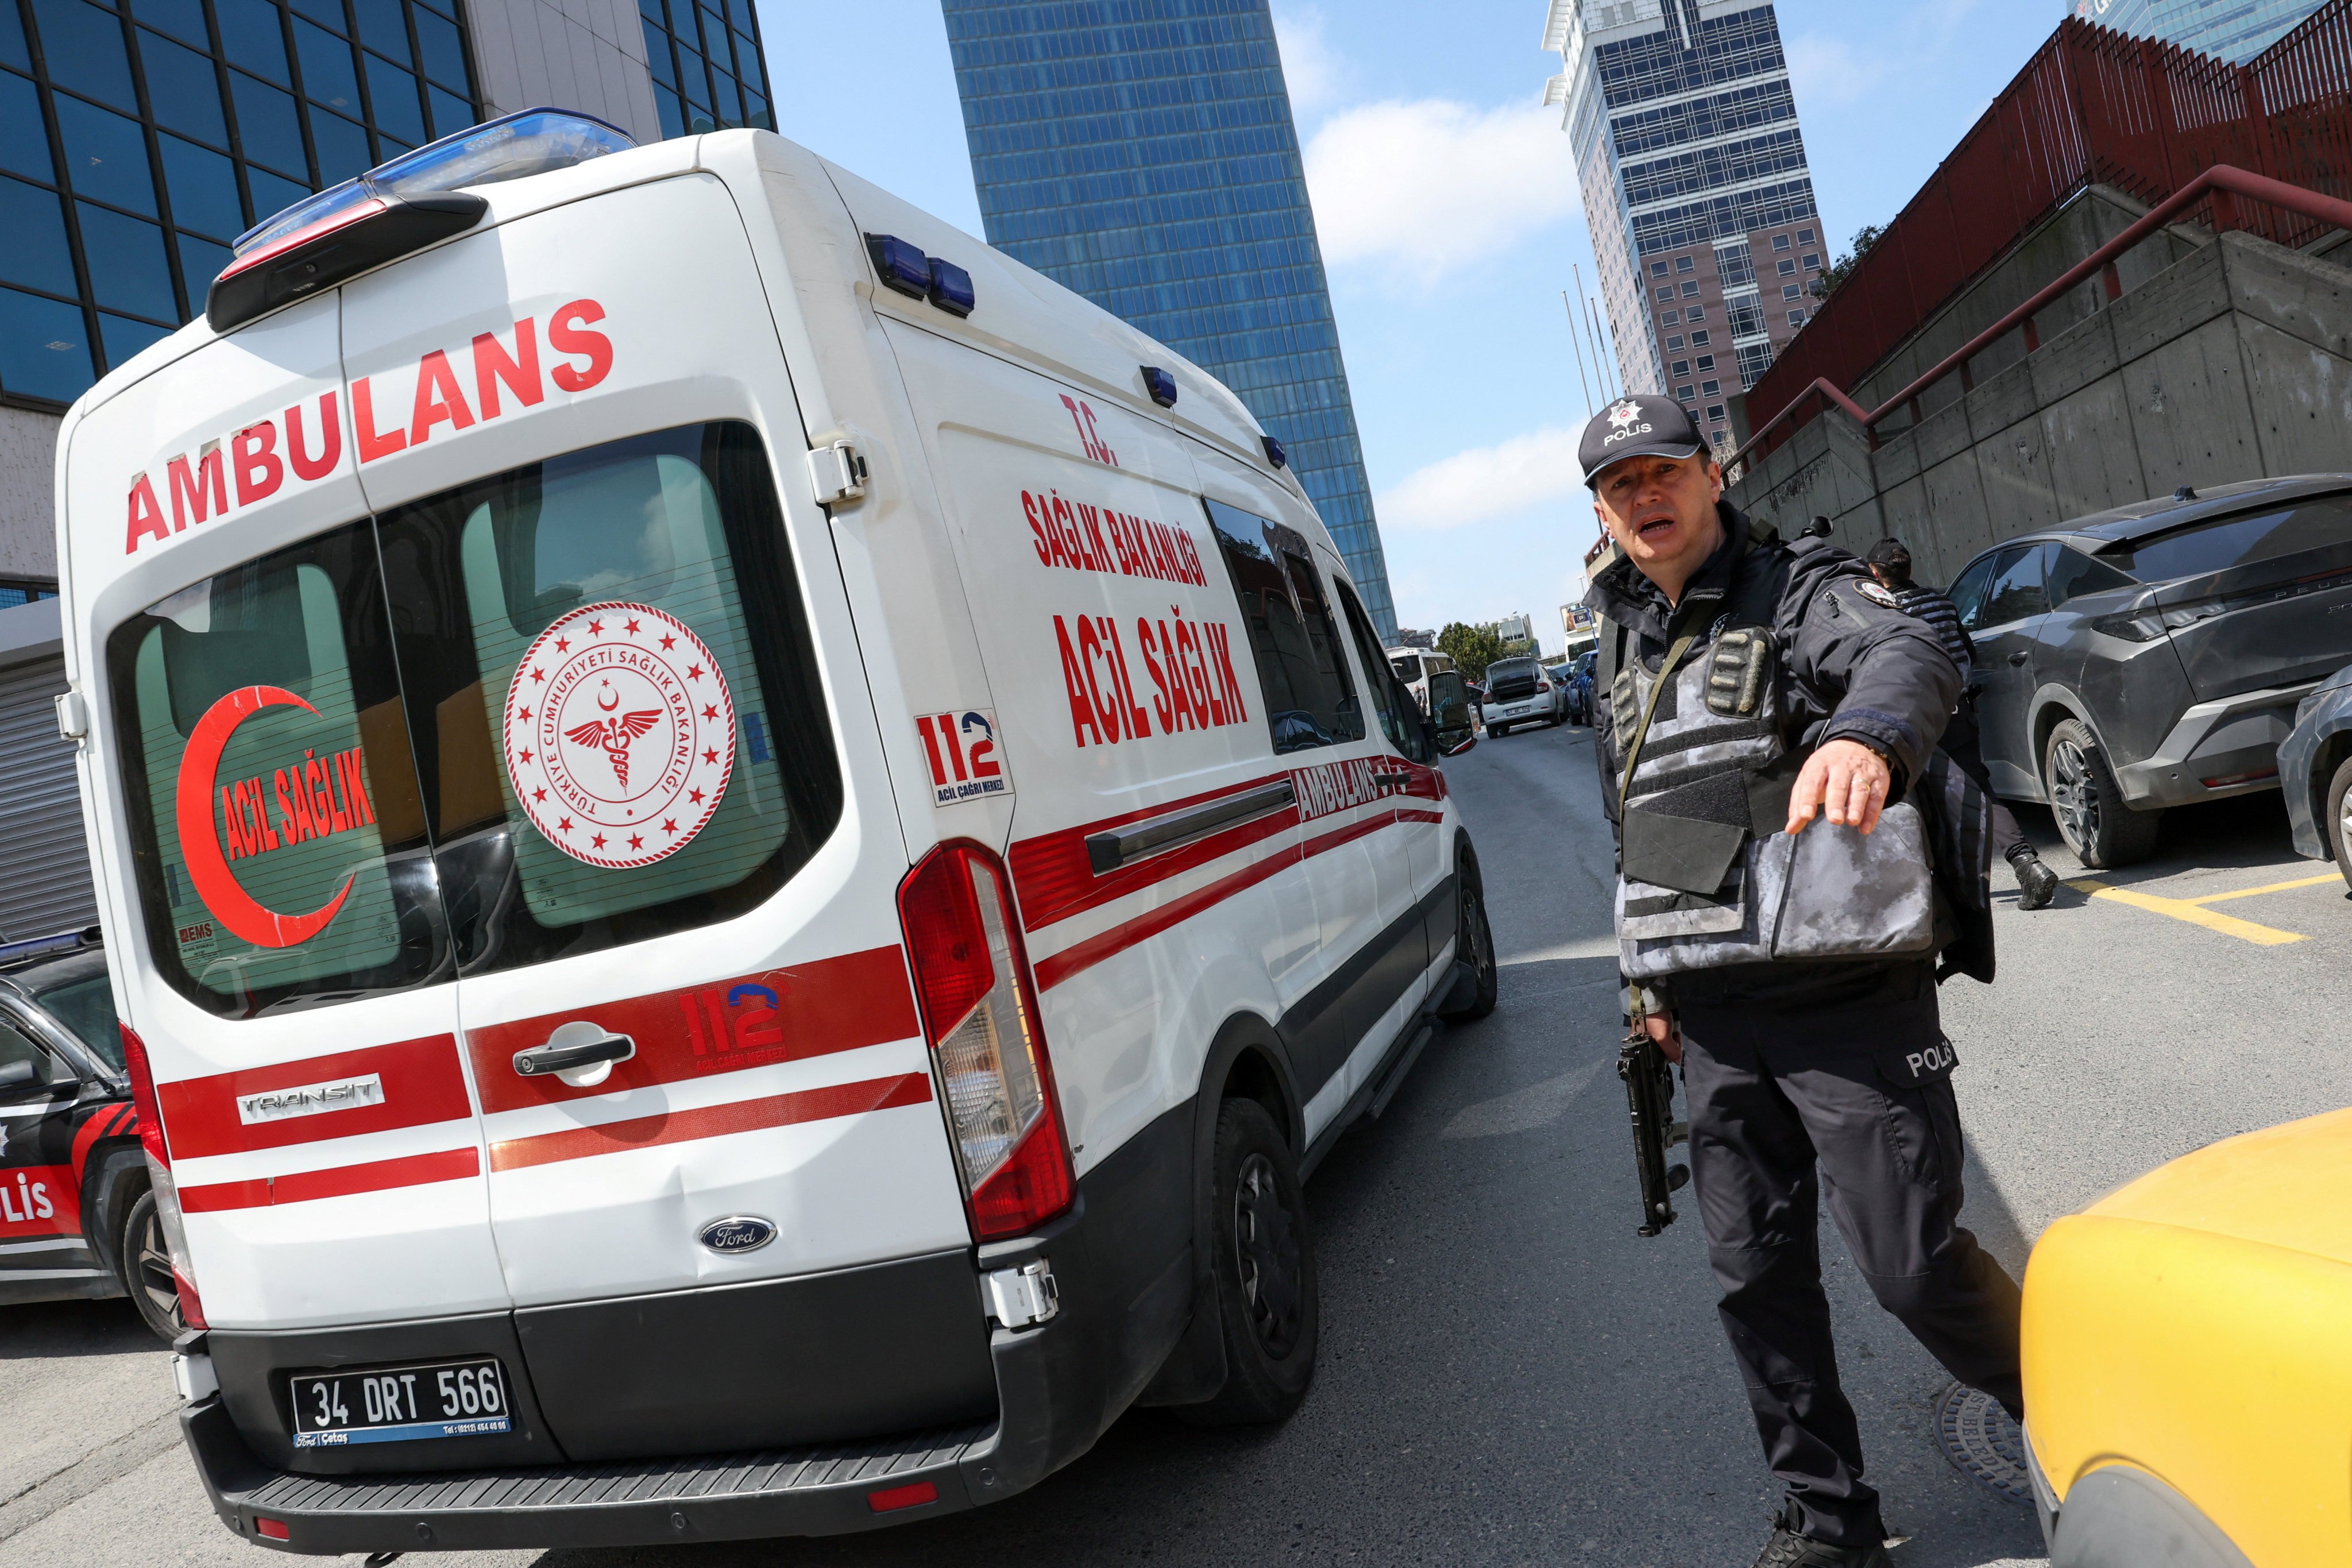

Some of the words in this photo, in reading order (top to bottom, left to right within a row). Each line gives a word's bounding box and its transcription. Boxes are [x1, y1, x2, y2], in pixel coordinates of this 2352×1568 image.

[126, 298, 613, 555] AMBULANS
[1058, 393, 1119, 467] T.C.
[1021, 488, 1117, 574] SAĞLIK
[543, 647, 613, 747] CUMHURİYETİ
[619, 650, 674, 690] SAĞLIK
[1137, 604, 1248, 736] SAĞLIK
[661, 693, 690, 795] BAKANLIĞI
[916, 711, 1001, 786] 112
[221, 776, 280, 862] ACİL
[274, 747, 376, 846] SAĞLIK
[546, 752, 596, 815] TÜRKİYE
[937, 786, 958, 802] ACİL
[957, 781, 983, 800] ÇAĞRI
[982, 777, 1005, 793] MERKEZİ
[1294, 758, 1378, 821] AMBULANS
[678, 982, 784, 1056] 112
[238, 1080, 377, 1112] TRANSIT
[0, 1172, 54, 1223] LİS
[715, 1225, 756, 1248] Ford
[311, 1380, 349, 1427] 34
[362, 1374, 418, 1423] DRT
[437, 1366, 500, 1417] 566
[458, 1423, 477, 1434] (0212)
[477, 1422, 489, 1432] 454
[489, 1422, 498, 1431] 40
[497, 1421, 507, 1430] 00
[296, 1435, 317, 1447] Ford
[322, 1432, 349, 1446] Çetaş
